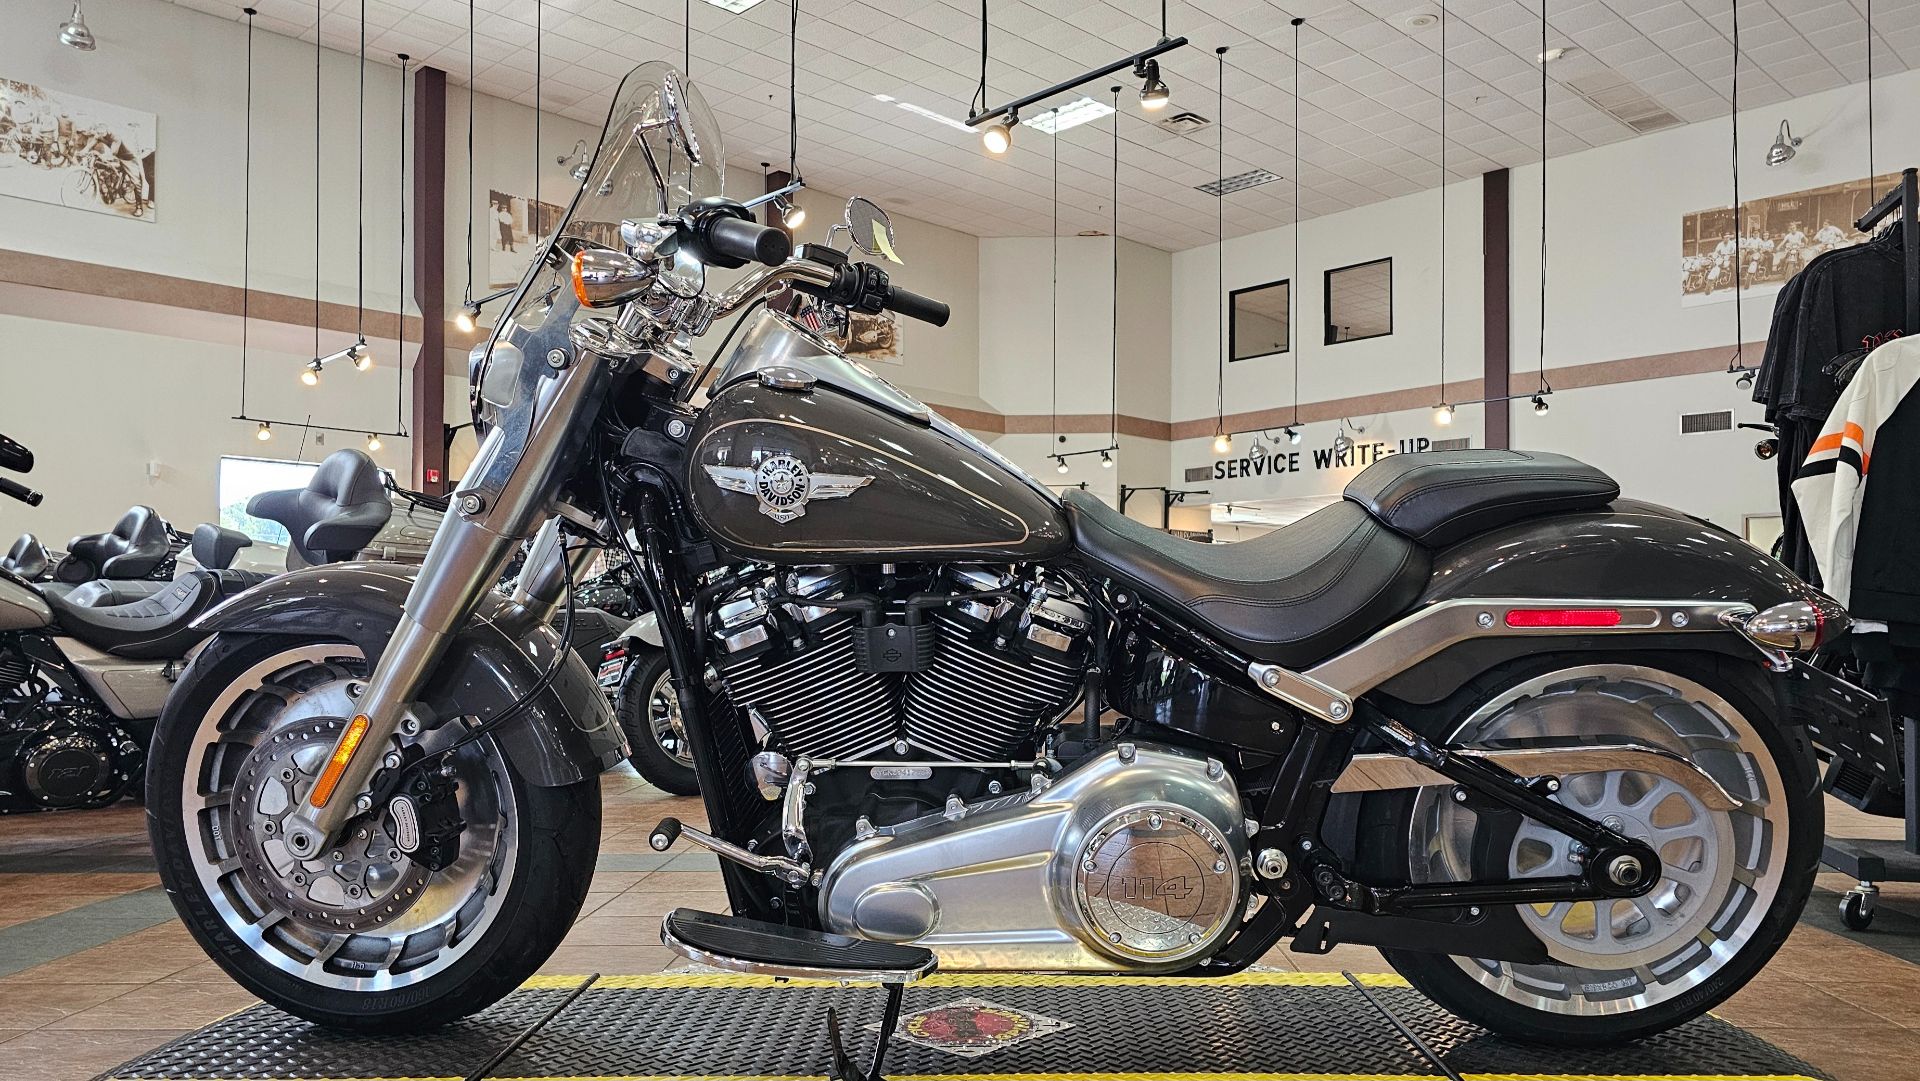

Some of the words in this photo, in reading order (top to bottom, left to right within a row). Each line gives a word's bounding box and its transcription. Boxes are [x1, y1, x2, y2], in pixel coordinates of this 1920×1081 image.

[763, 459, 804, 478] HARLEY
[1214, 452, 1300, 480] SERVICE
[1313, 438, 1430, 470] WRITE-UP
[758, 482, 806, 506] DAVIDSON
[1121, 876, 1194, 900] 114
